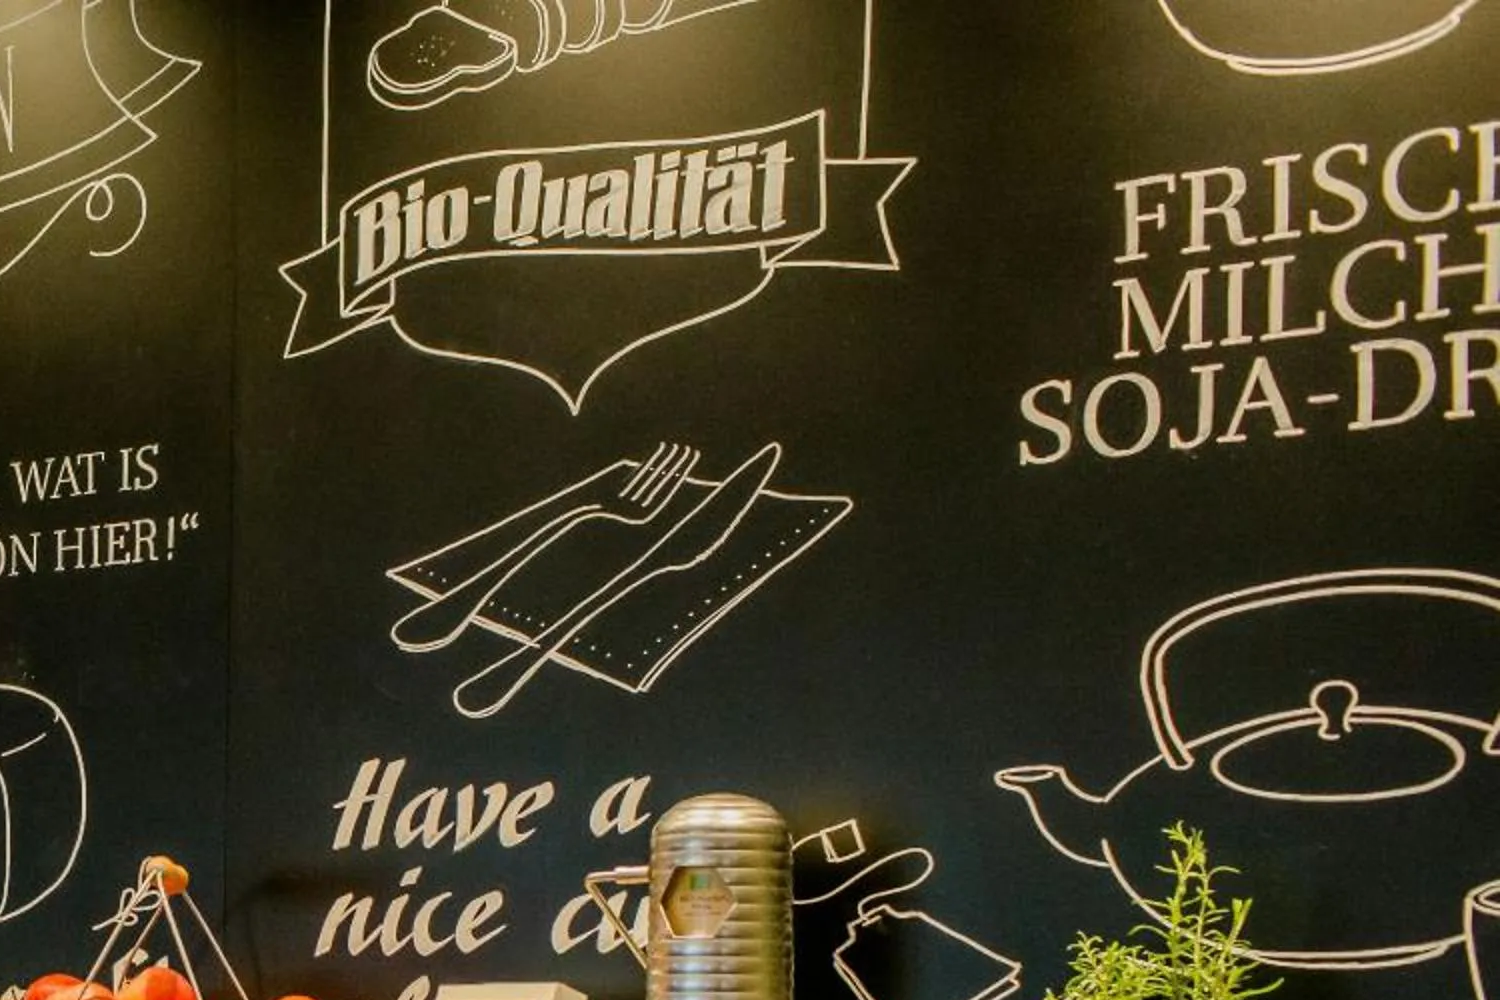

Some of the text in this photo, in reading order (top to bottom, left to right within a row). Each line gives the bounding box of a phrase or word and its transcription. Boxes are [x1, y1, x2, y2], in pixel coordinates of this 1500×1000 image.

[354, 140, 795, 286] Bio-Qualität
[10, 451, 105, 503] WAT
[118, 443, 159, 493] IS
[332, 757, 651, 852] Have a
[314, 866, 651, 957] nice cu
